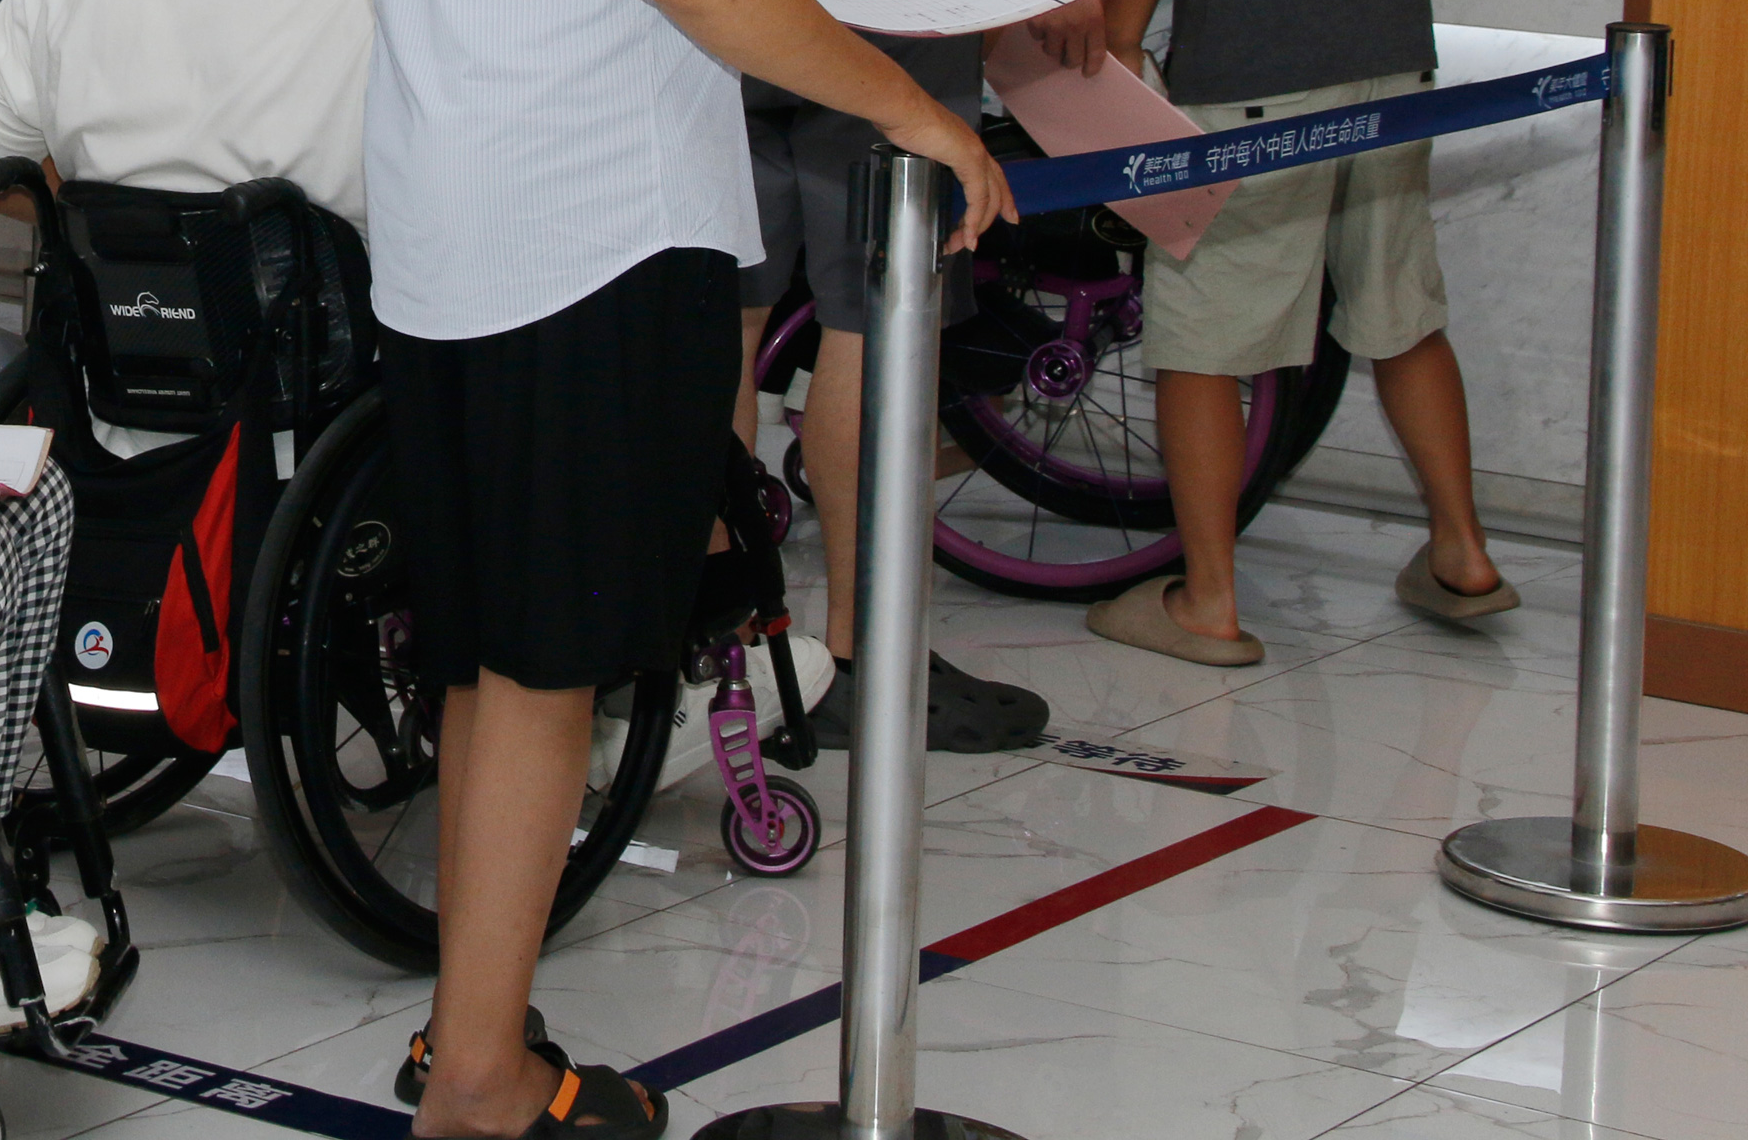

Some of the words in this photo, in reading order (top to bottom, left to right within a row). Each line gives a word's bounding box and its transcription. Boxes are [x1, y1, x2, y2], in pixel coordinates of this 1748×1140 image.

[1205, 112, 1382, 173] 守护每个中国人的生命质量
[1143, 151, 1191, 175] 美年大健康
[1143, 173, 1173, 187] Health
[1175, 170, 1190, 181] 100
